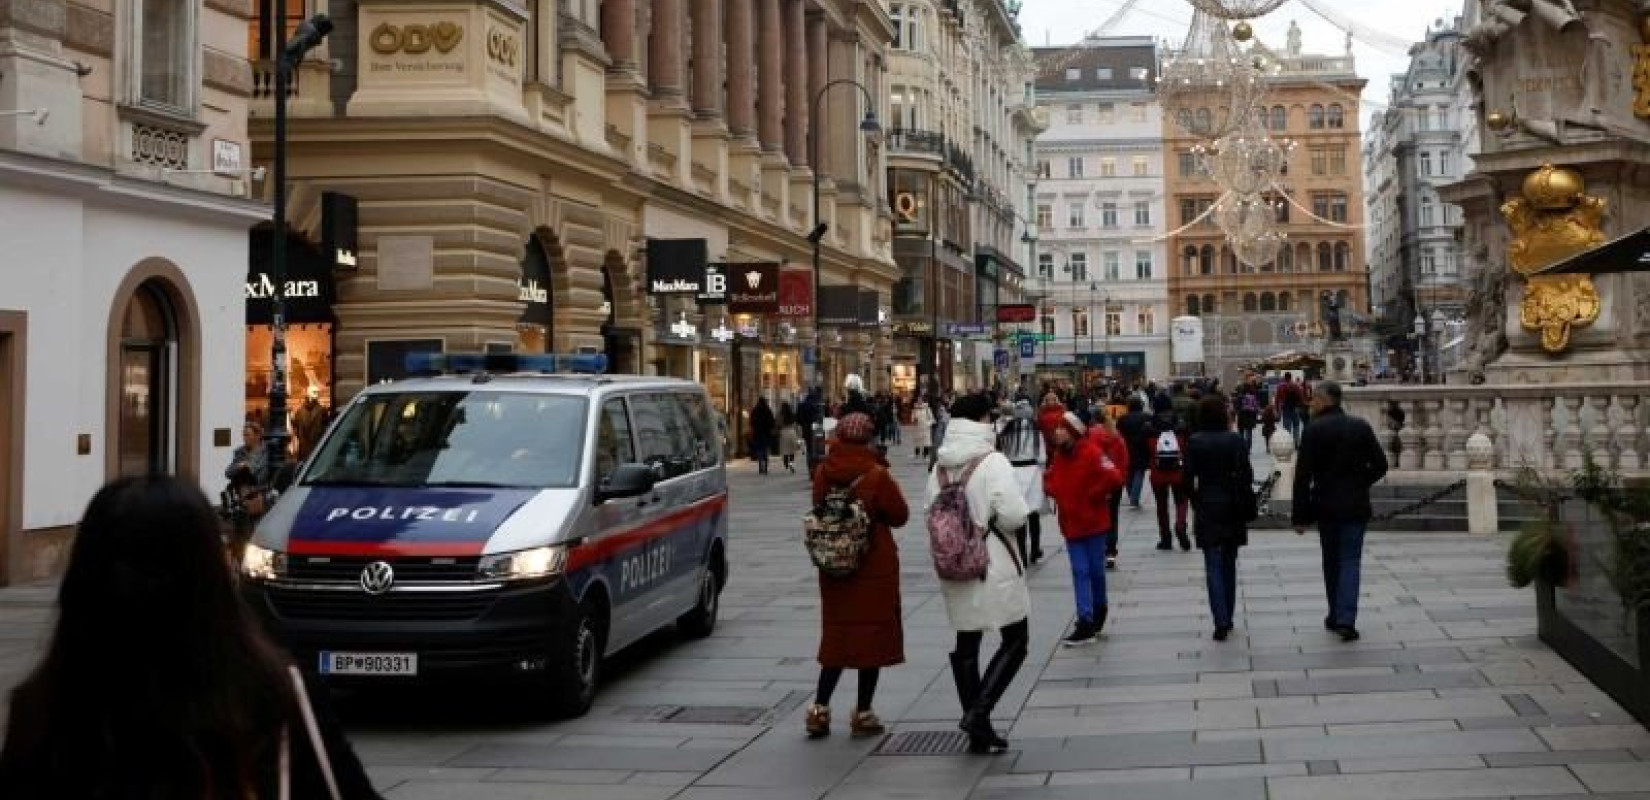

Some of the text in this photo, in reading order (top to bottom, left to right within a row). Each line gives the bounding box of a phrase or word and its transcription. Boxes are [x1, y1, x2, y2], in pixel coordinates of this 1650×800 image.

[652, 279, 699, 293] MaxMara
[326, 506, 479, 522] POLIZEI
[620, 542, 671, 595] POLIZEI
[364, 656, 410, 672] 90331
